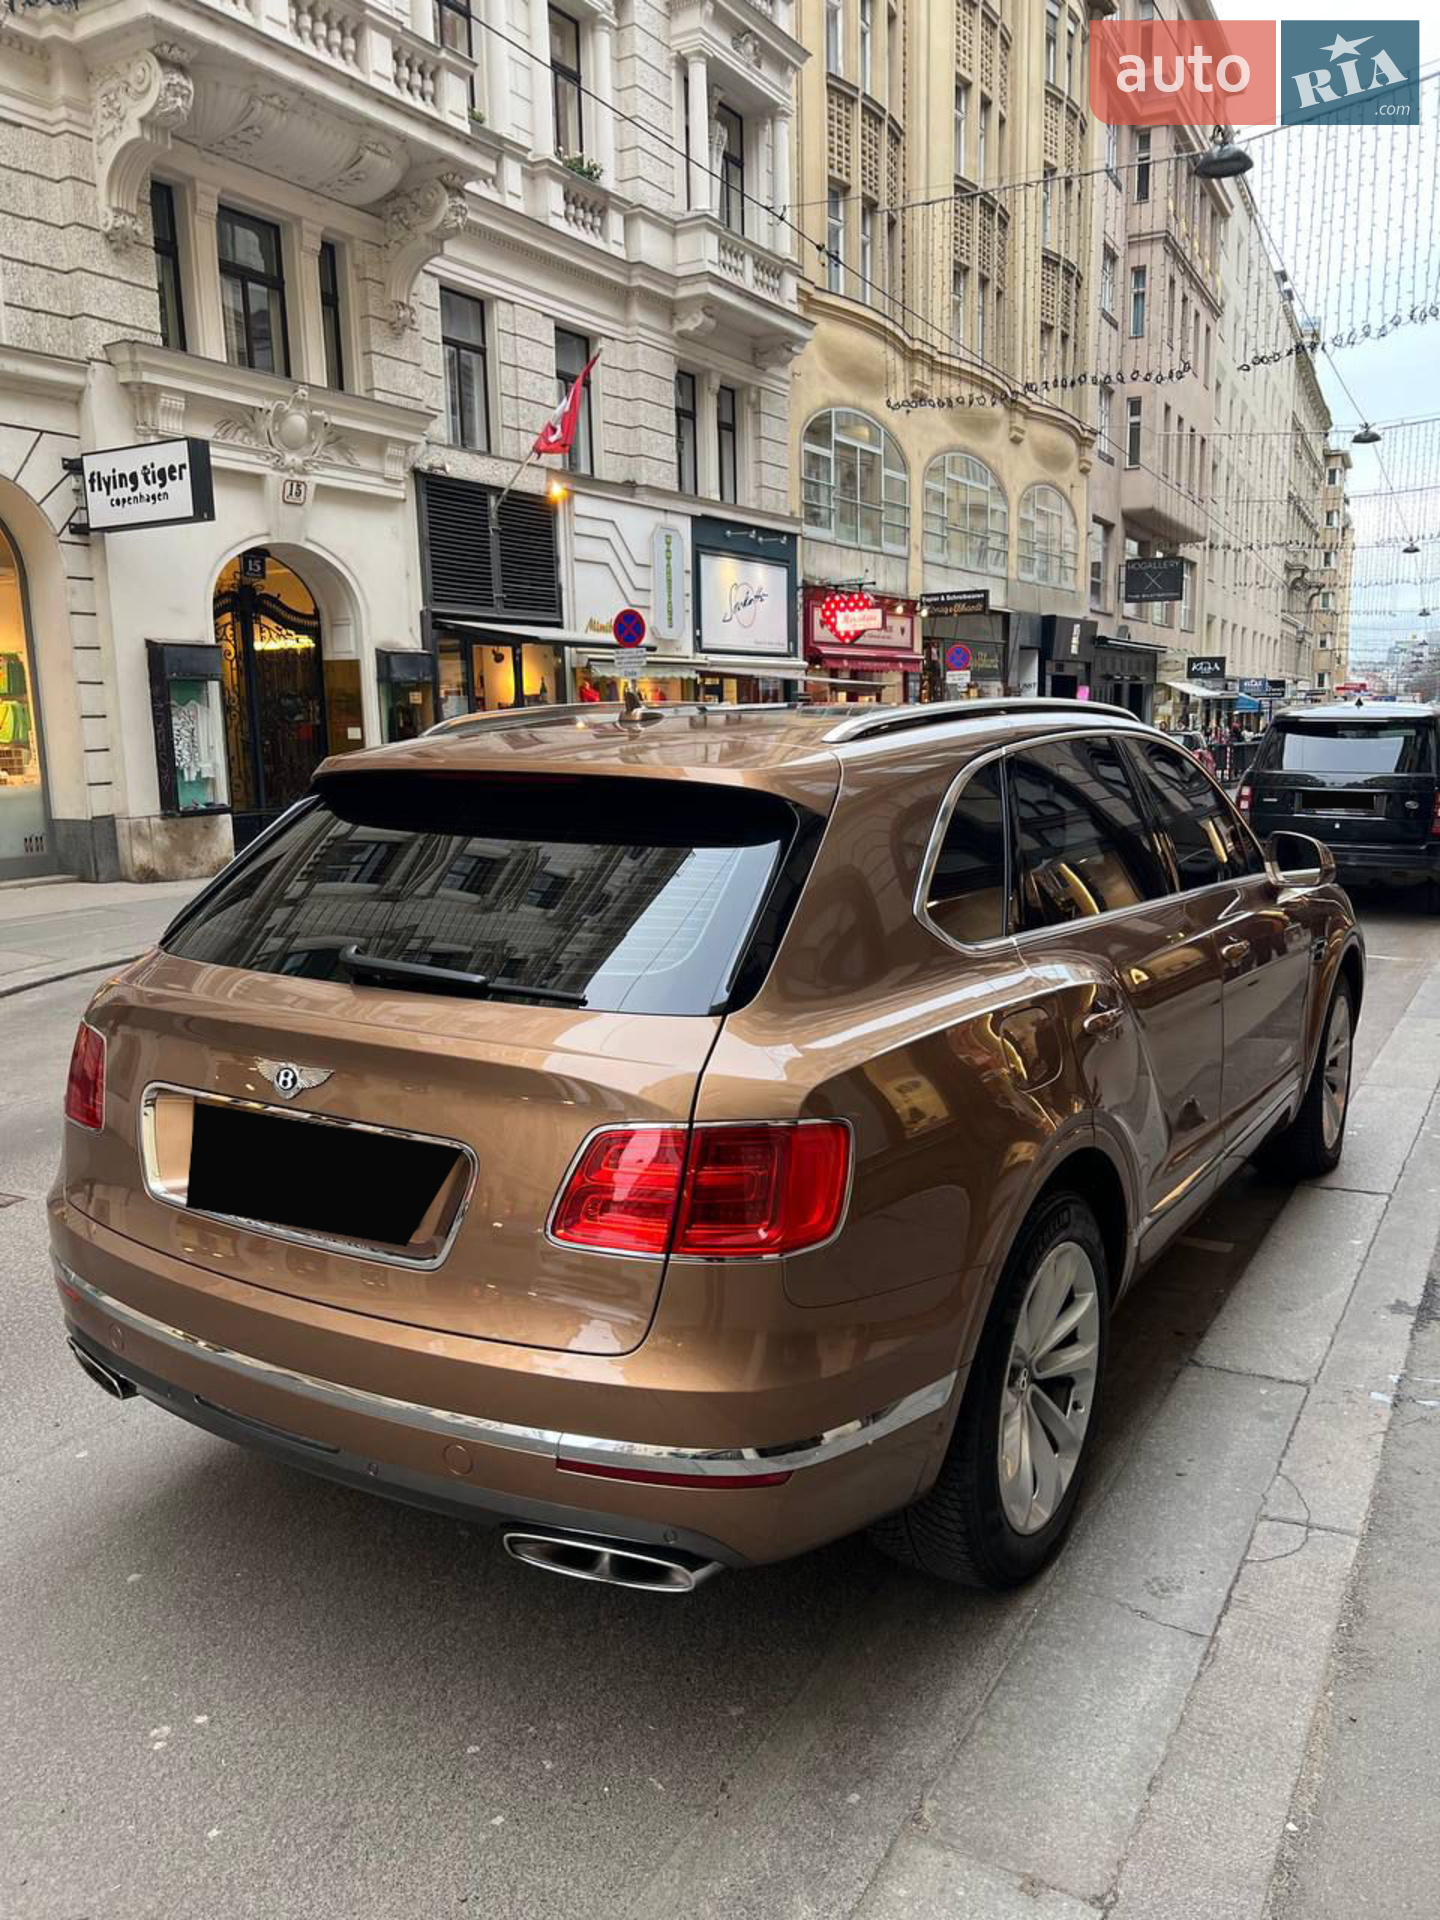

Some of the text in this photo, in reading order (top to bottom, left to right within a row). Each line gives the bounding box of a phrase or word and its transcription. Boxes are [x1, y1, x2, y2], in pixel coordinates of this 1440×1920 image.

[88, 461, 187, 496] flying tiger
[286, 482, 303, 499] 15
[109, 491, 169, 508] copenhagen
[248, 559, 262, 573] 15
